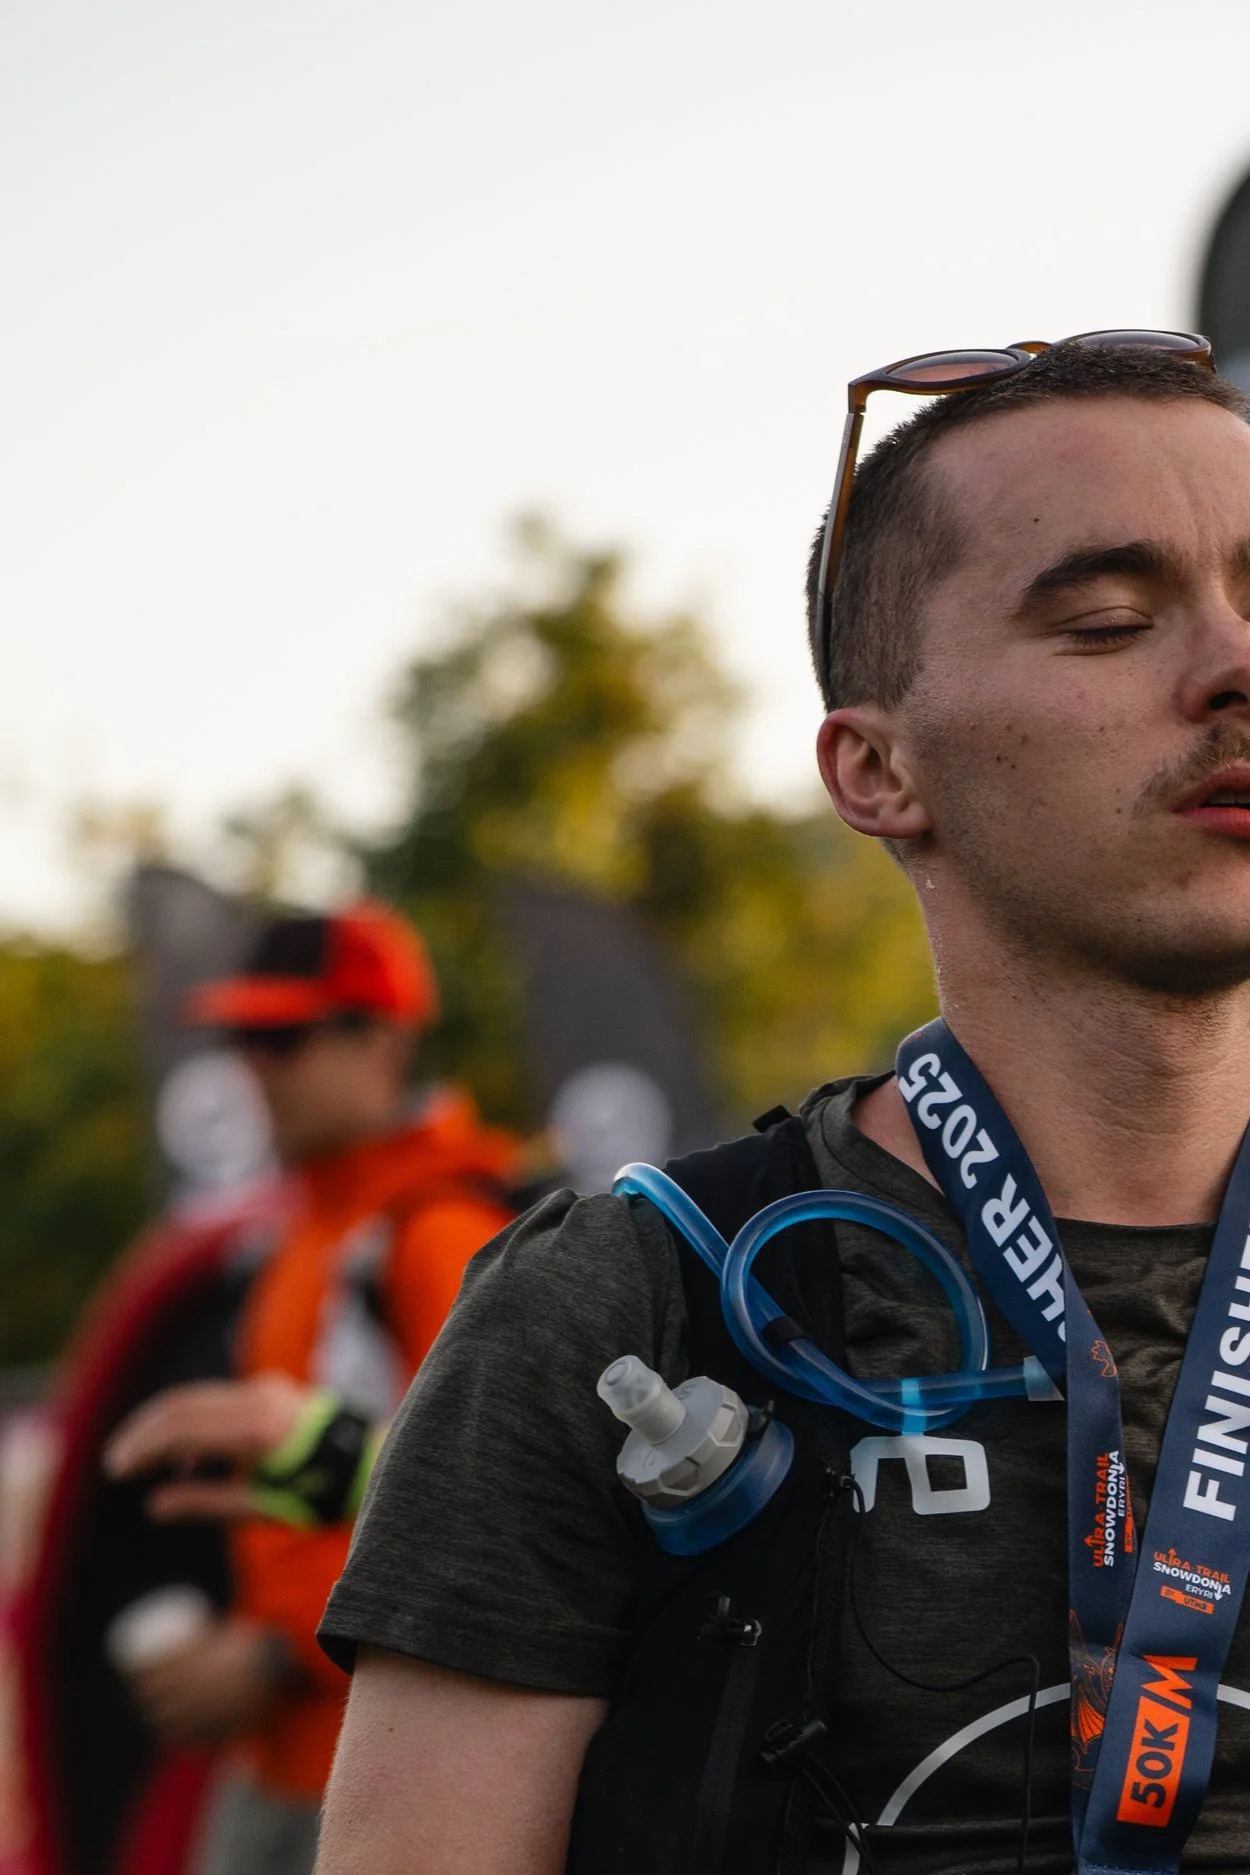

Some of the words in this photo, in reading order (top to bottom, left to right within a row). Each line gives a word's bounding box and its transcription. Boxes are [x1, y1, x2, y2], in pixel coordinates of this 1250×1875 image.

[898, 1052, 998, 1189] 2025
[1104, 1450, 1122, 1567] SNOWDONIA
[1153, 1562, 1231, 1597] SNOWDONIA
[1185, 1584, 1213, 1599] ERYRI
[1130, 1715, 1181, 1810] 50K
